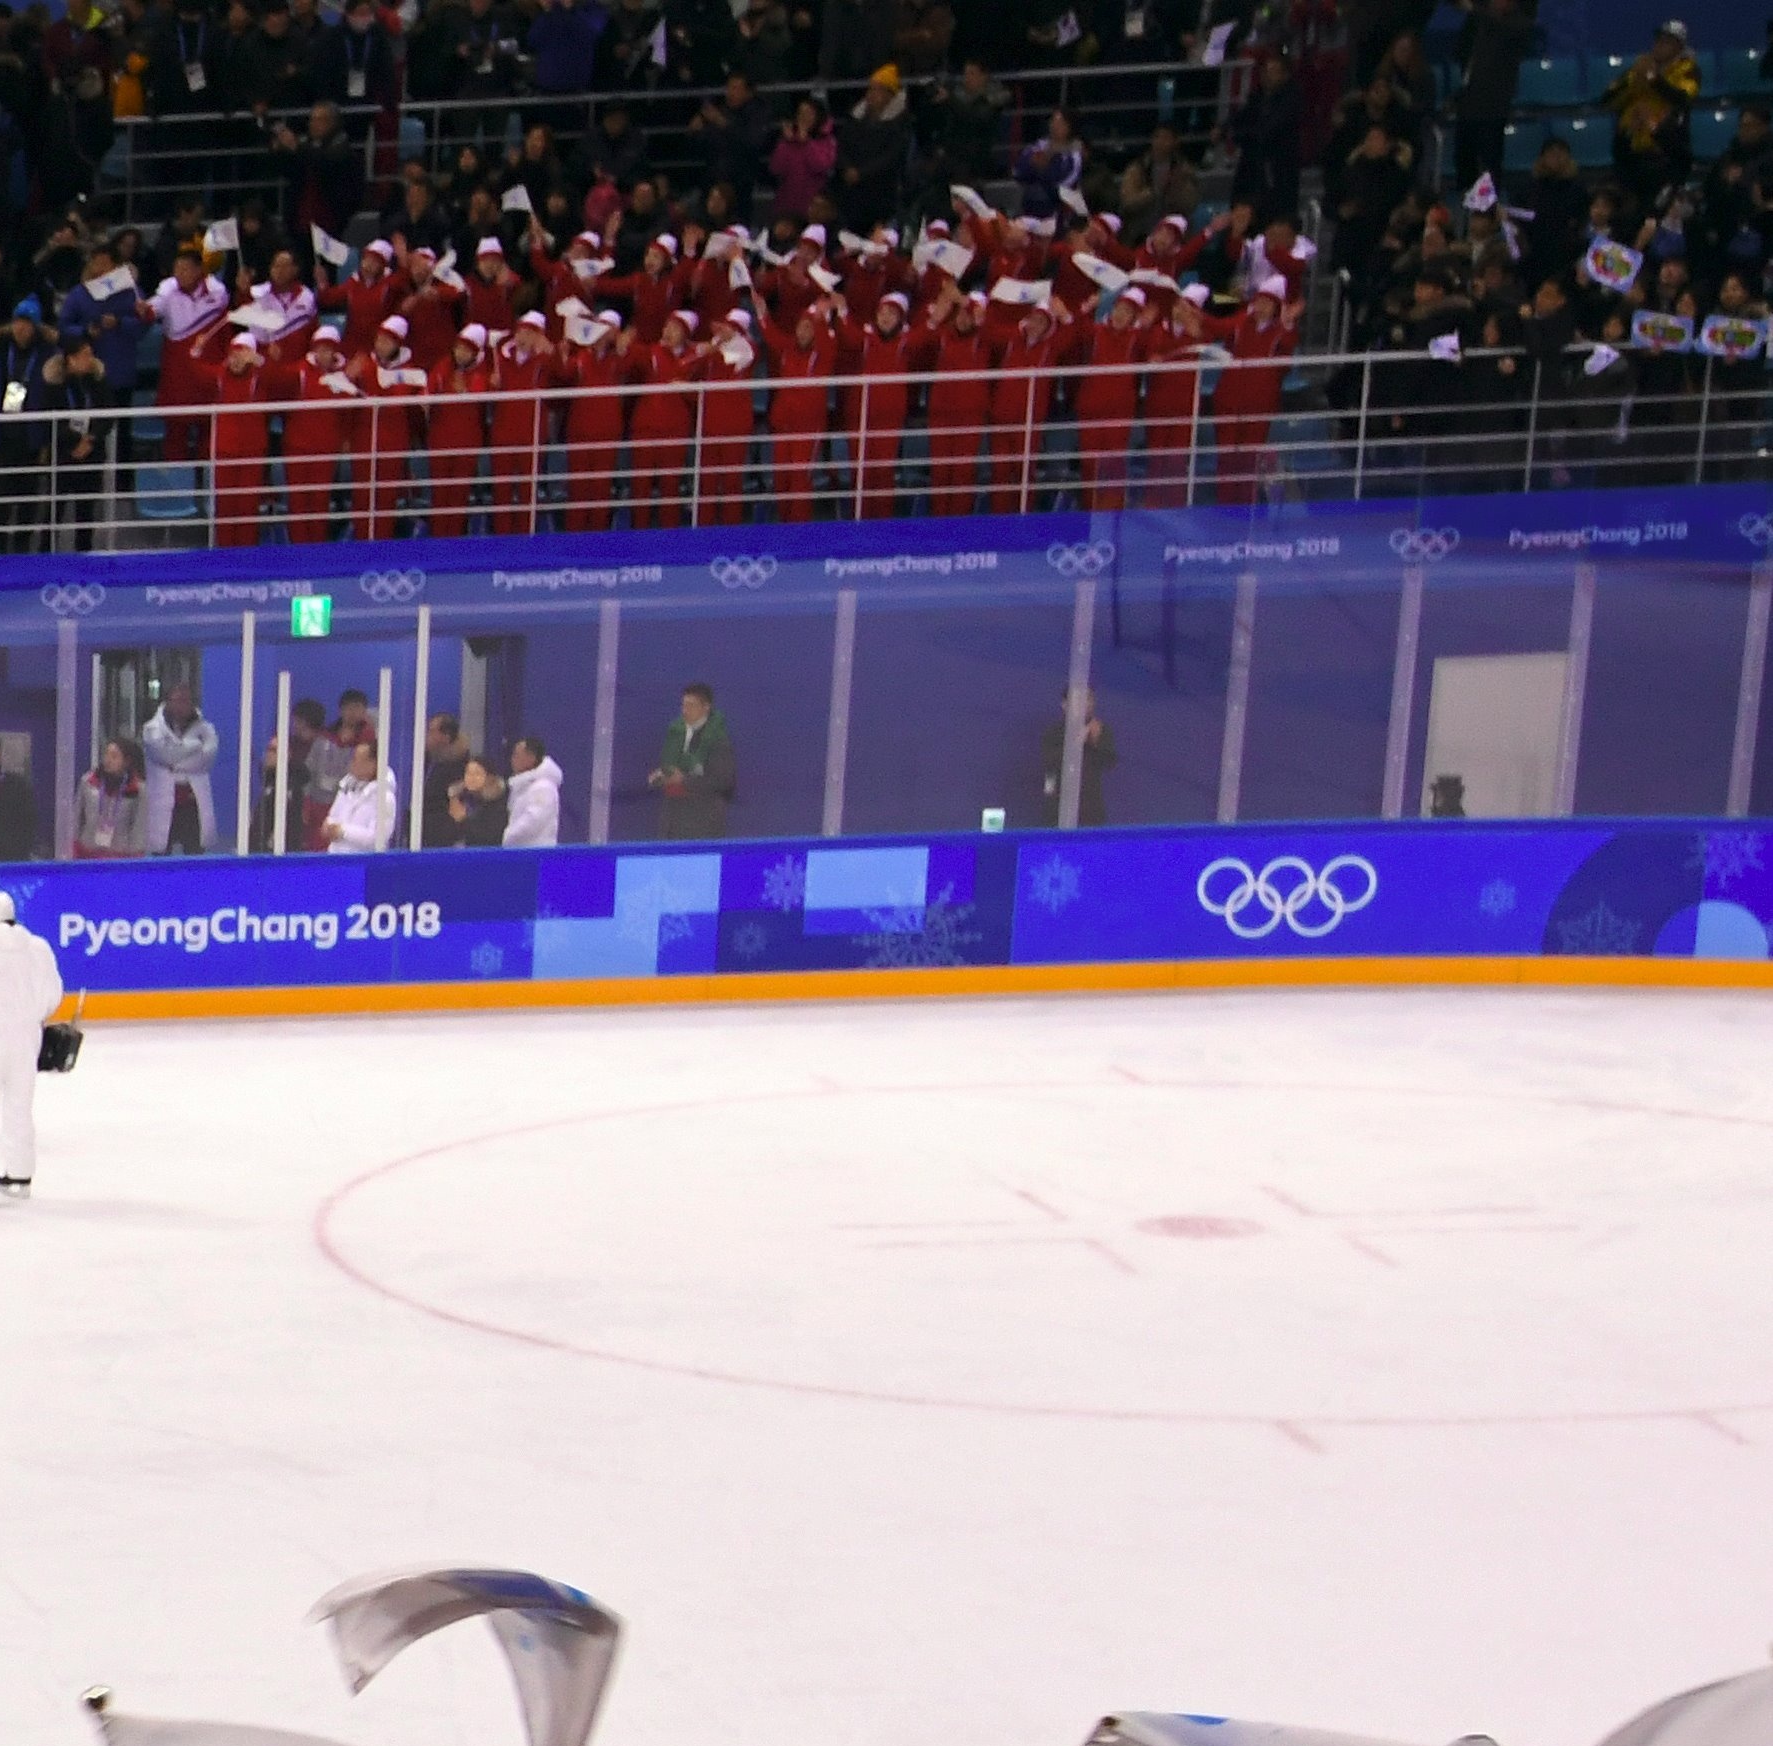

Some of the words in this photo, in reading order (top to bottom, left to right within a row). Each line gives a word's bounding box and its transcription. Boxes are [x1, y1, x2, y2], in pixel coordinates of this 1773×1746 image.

[1508, 526, 1641, 551] PyeongChang
[1642, 522, 1688, 542] 2018
[823, 555, 951, 579] PyeongChang
[952, 552, 997, 571] 2018
[1164, 543, 1293, 566] PyeongChang
[1295, 538, 1339, 557] 2018
[492, 568, 617, 592] PyeongChang
[618, 566, 662, 584] 2018
[145, 582, 267, 606] PyeongChang
[59, 906, 340, 957] PyeongChang
[344, 901, 442, 939] 2018
